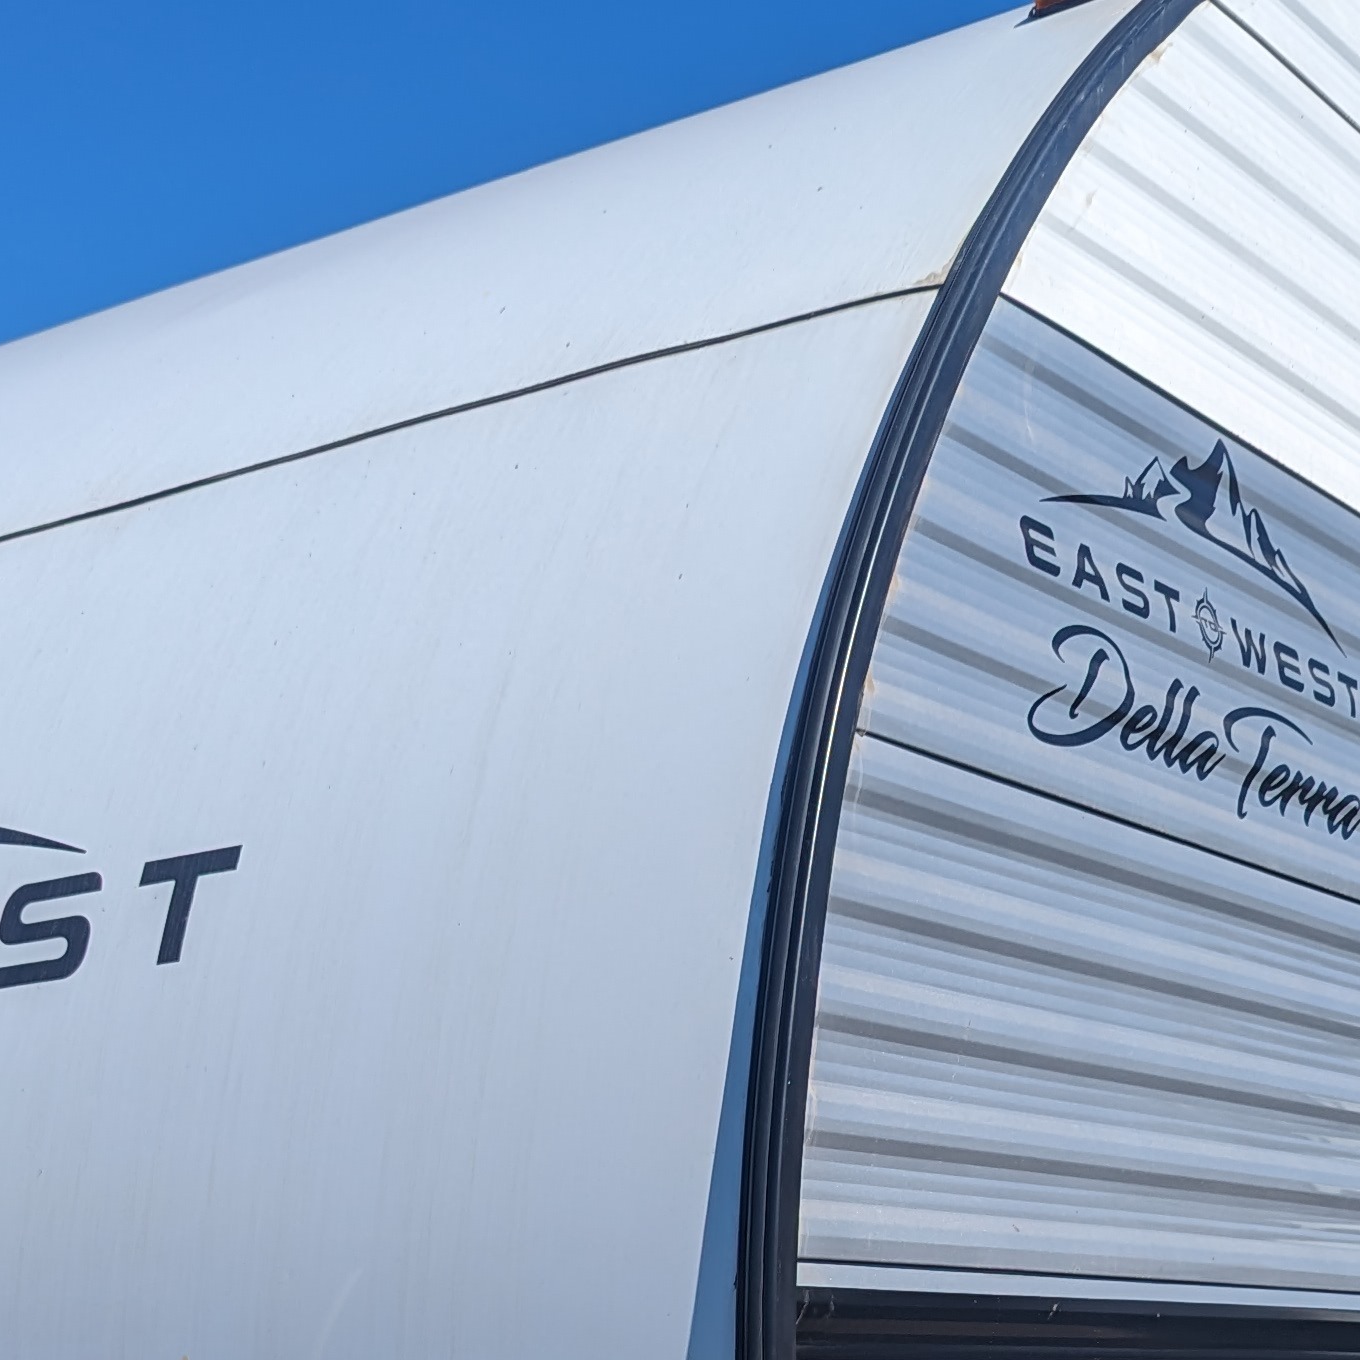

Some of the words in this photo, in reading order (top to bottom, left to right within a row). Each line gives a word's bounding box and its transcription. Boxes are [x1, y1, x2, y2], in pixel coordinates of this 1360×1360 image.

[1019, 515, 1180, 634] EAST
[1200, 616, 1219, 633] TO
[1230, 616, 1358, 718] WEST
[1027, 624, 1227, 781] Della
